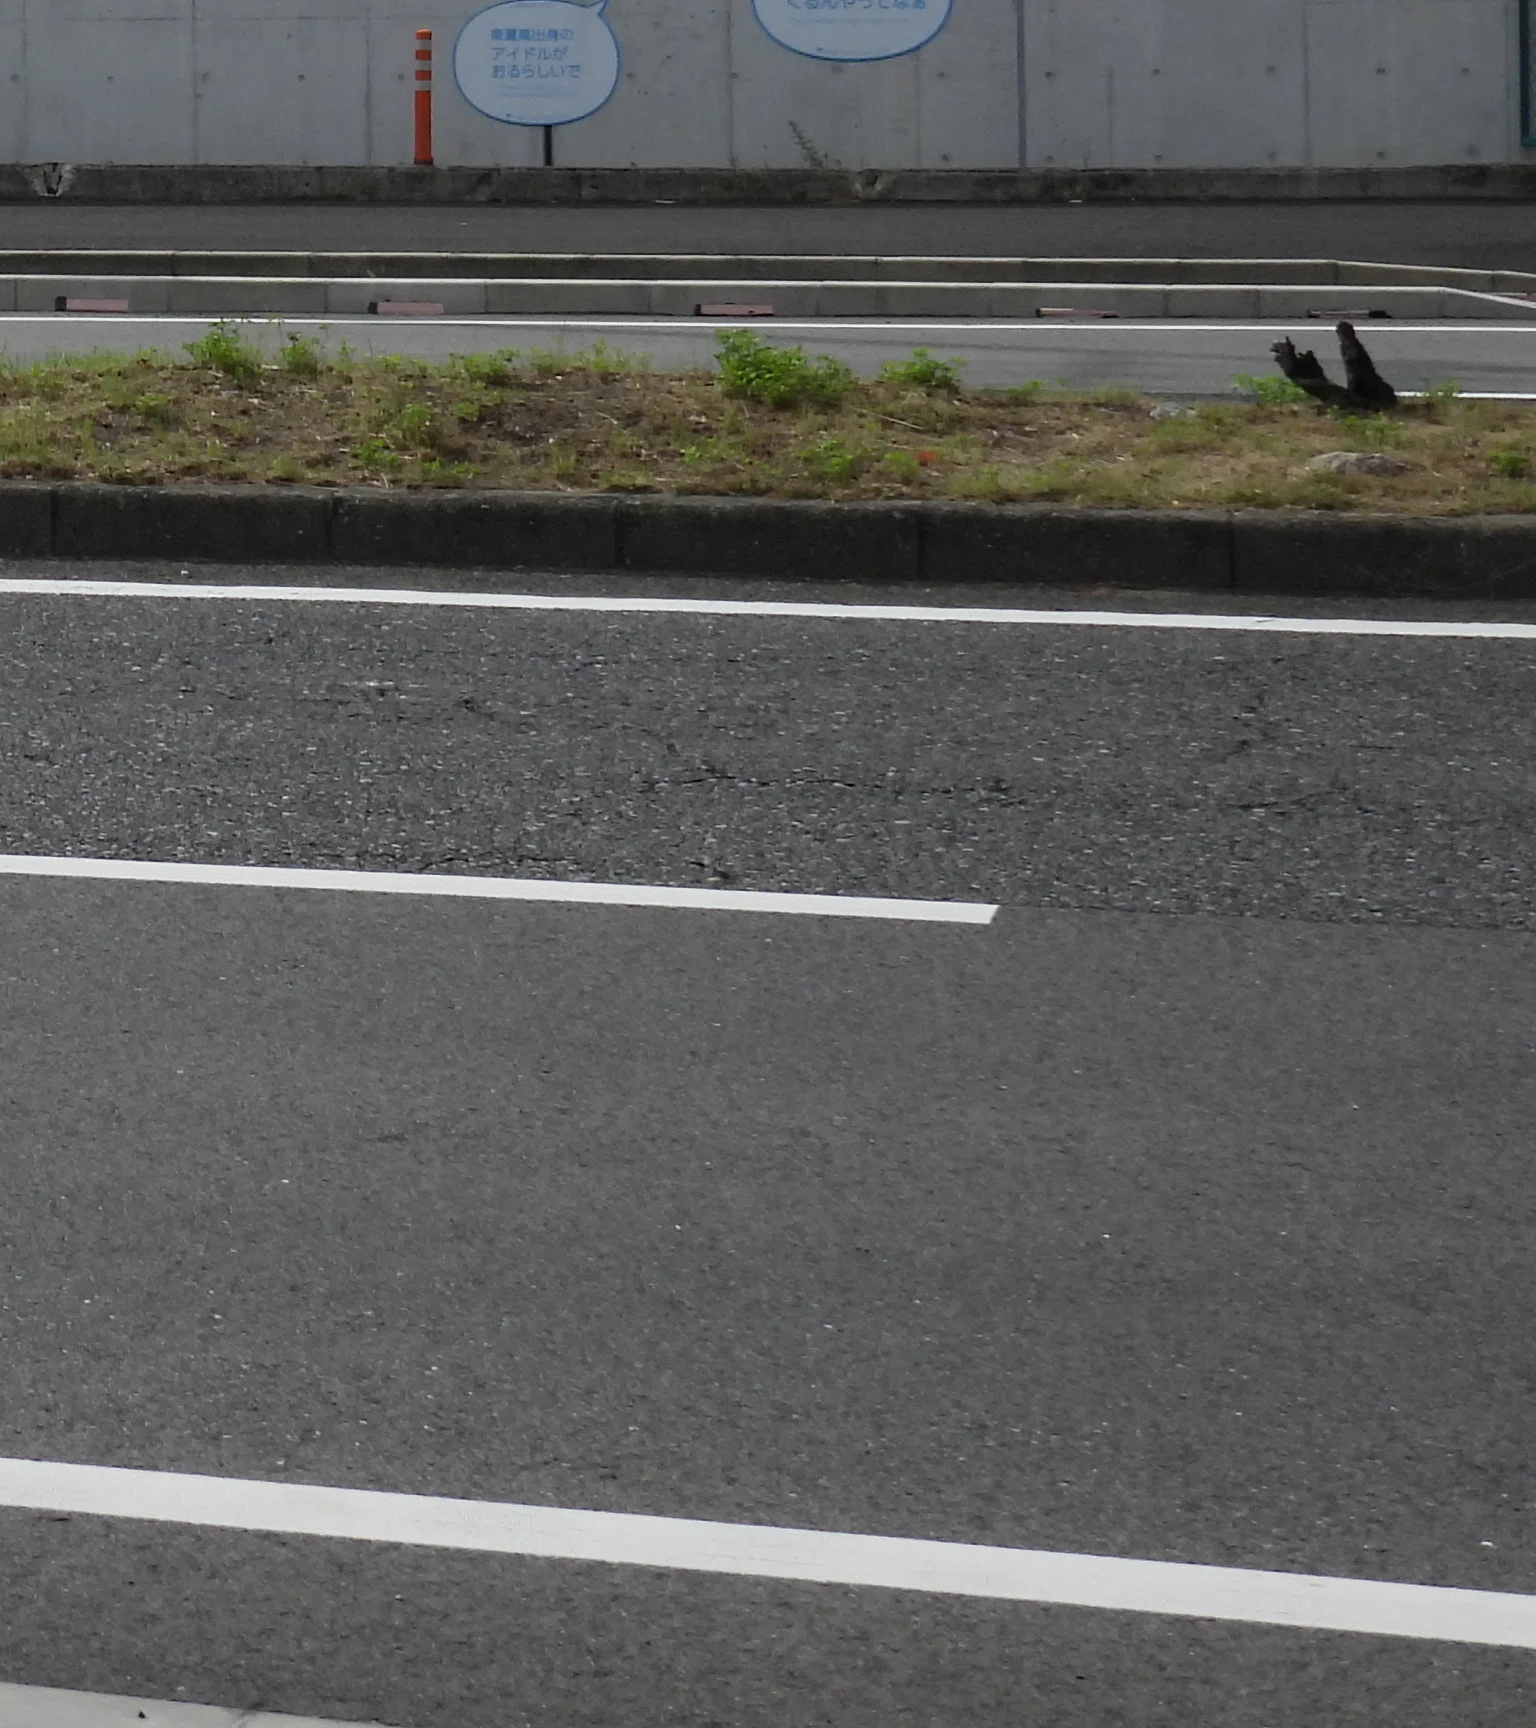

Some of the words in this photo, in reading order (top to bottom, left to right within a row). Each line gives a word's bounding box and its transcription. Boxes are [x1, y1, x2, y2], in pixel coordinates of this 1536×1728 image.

[490, 46, 570, 61] アイドルが
[491, 65, 581, 79] おるらしいで
